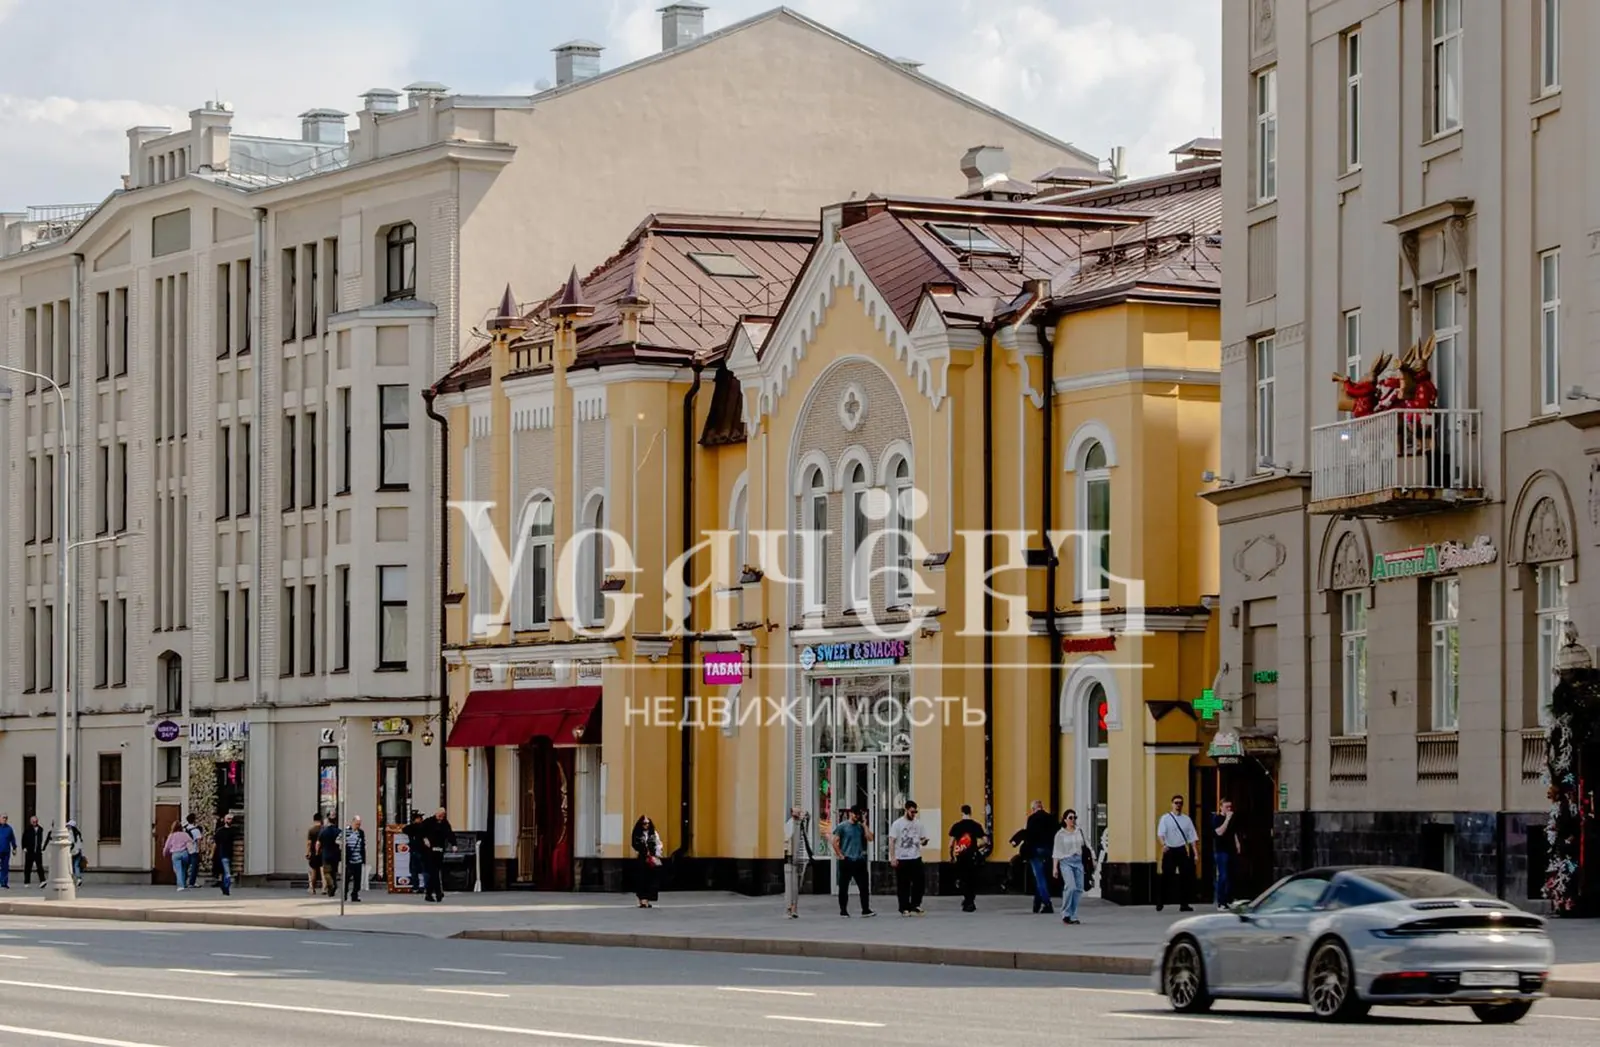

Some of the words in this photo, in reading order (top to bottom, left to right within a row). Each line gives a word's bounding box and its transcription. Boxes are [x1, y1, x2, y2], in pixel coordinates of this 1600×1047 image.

[817, 643, 851, 661] SWEET
[853, 642, 863, 660] &
[863, 640, 905, 658] SNACKS
[705, 662, 742, 676] ТАБАК
